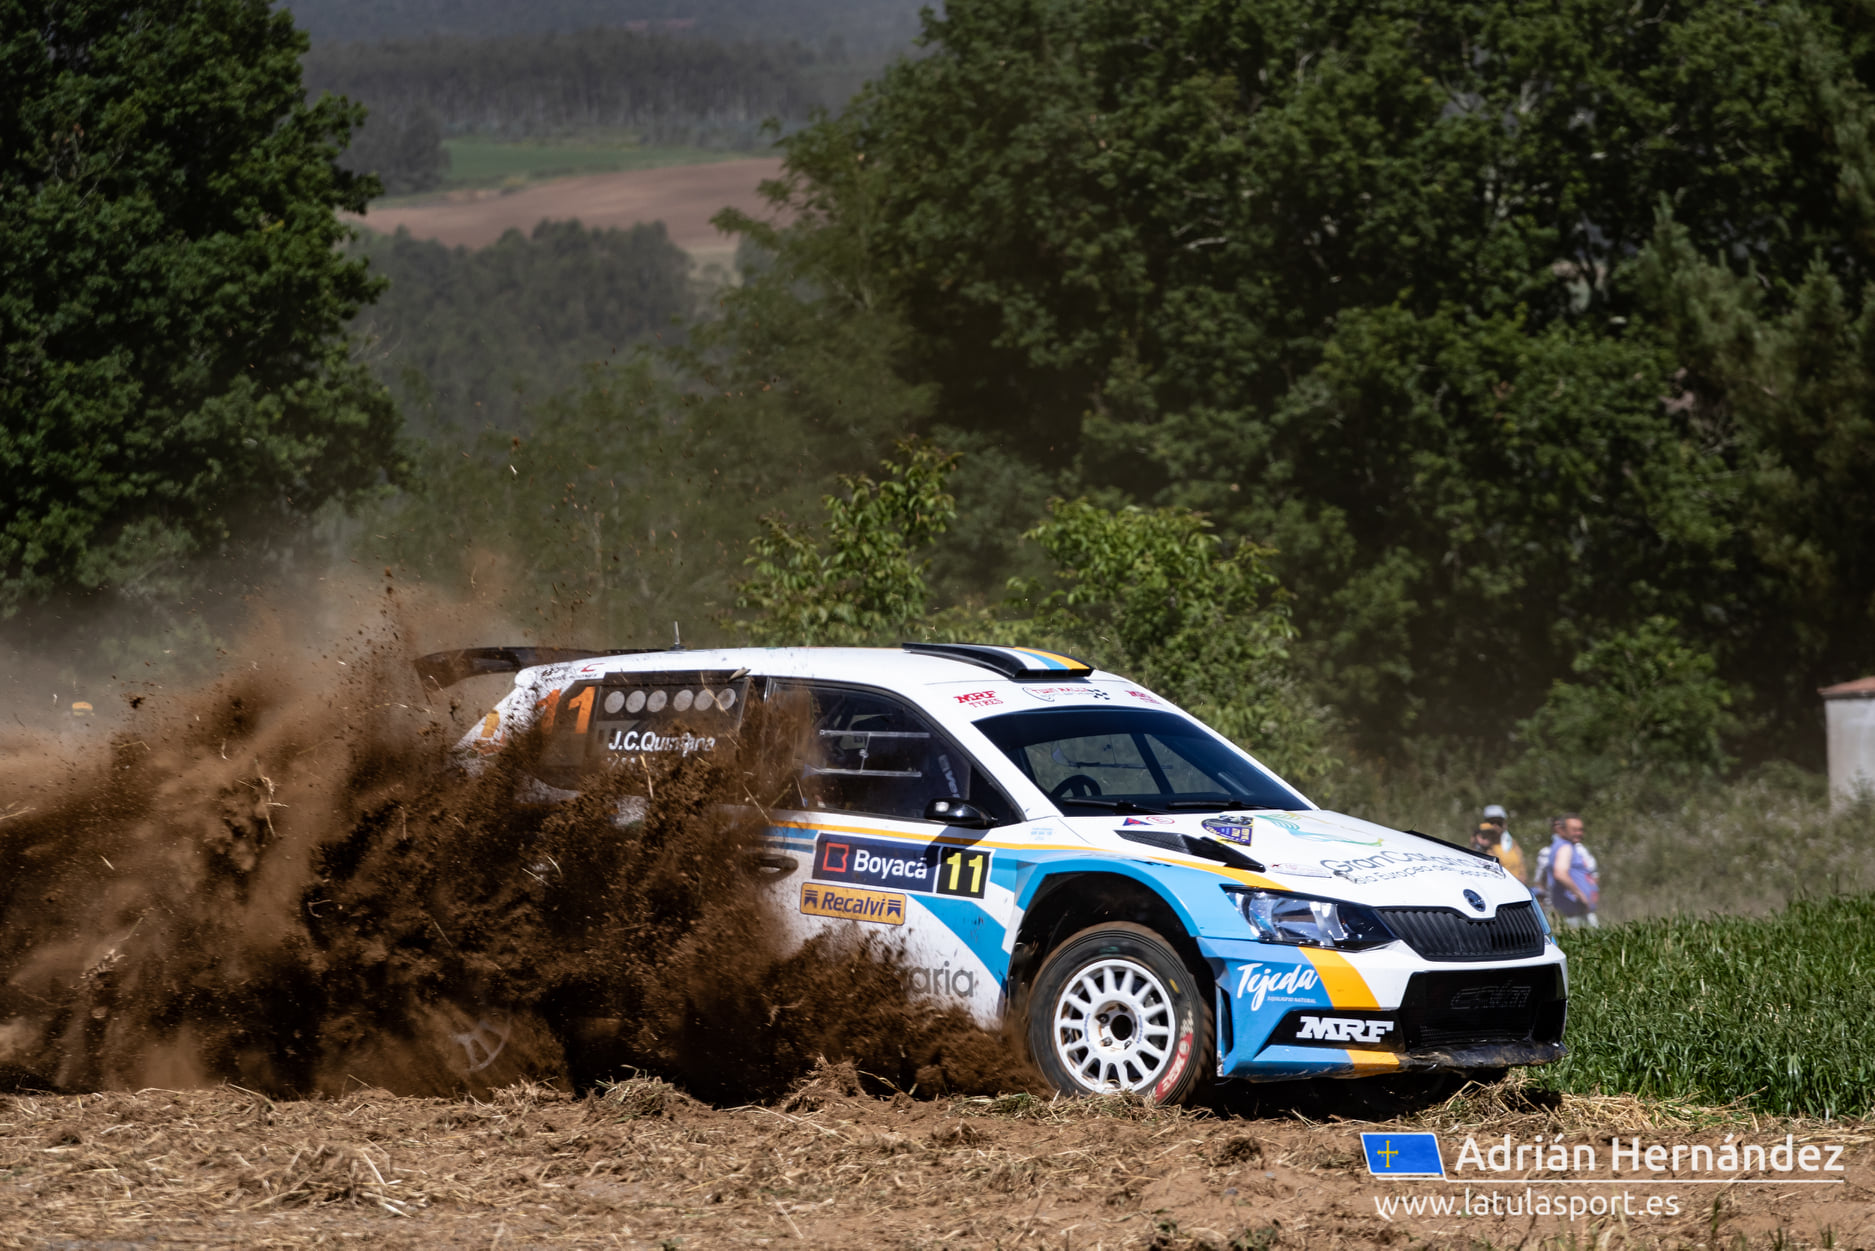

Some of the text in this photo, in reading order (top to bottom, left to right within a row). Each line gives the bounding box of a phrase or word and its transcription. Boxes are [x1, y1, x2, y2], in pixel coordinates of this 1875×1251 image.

[953, 690, 996, 704] MRF
[853, 849, 928, 880] Boyacá
[946, 852, 984, 893] 11
[821, 891, 885, 917] Recalvi
[911, 960, 974, 998] aria
[1236, 962, 1319, 1012] Tejeda
[1296, 1016, 1395, 1043] MRF
